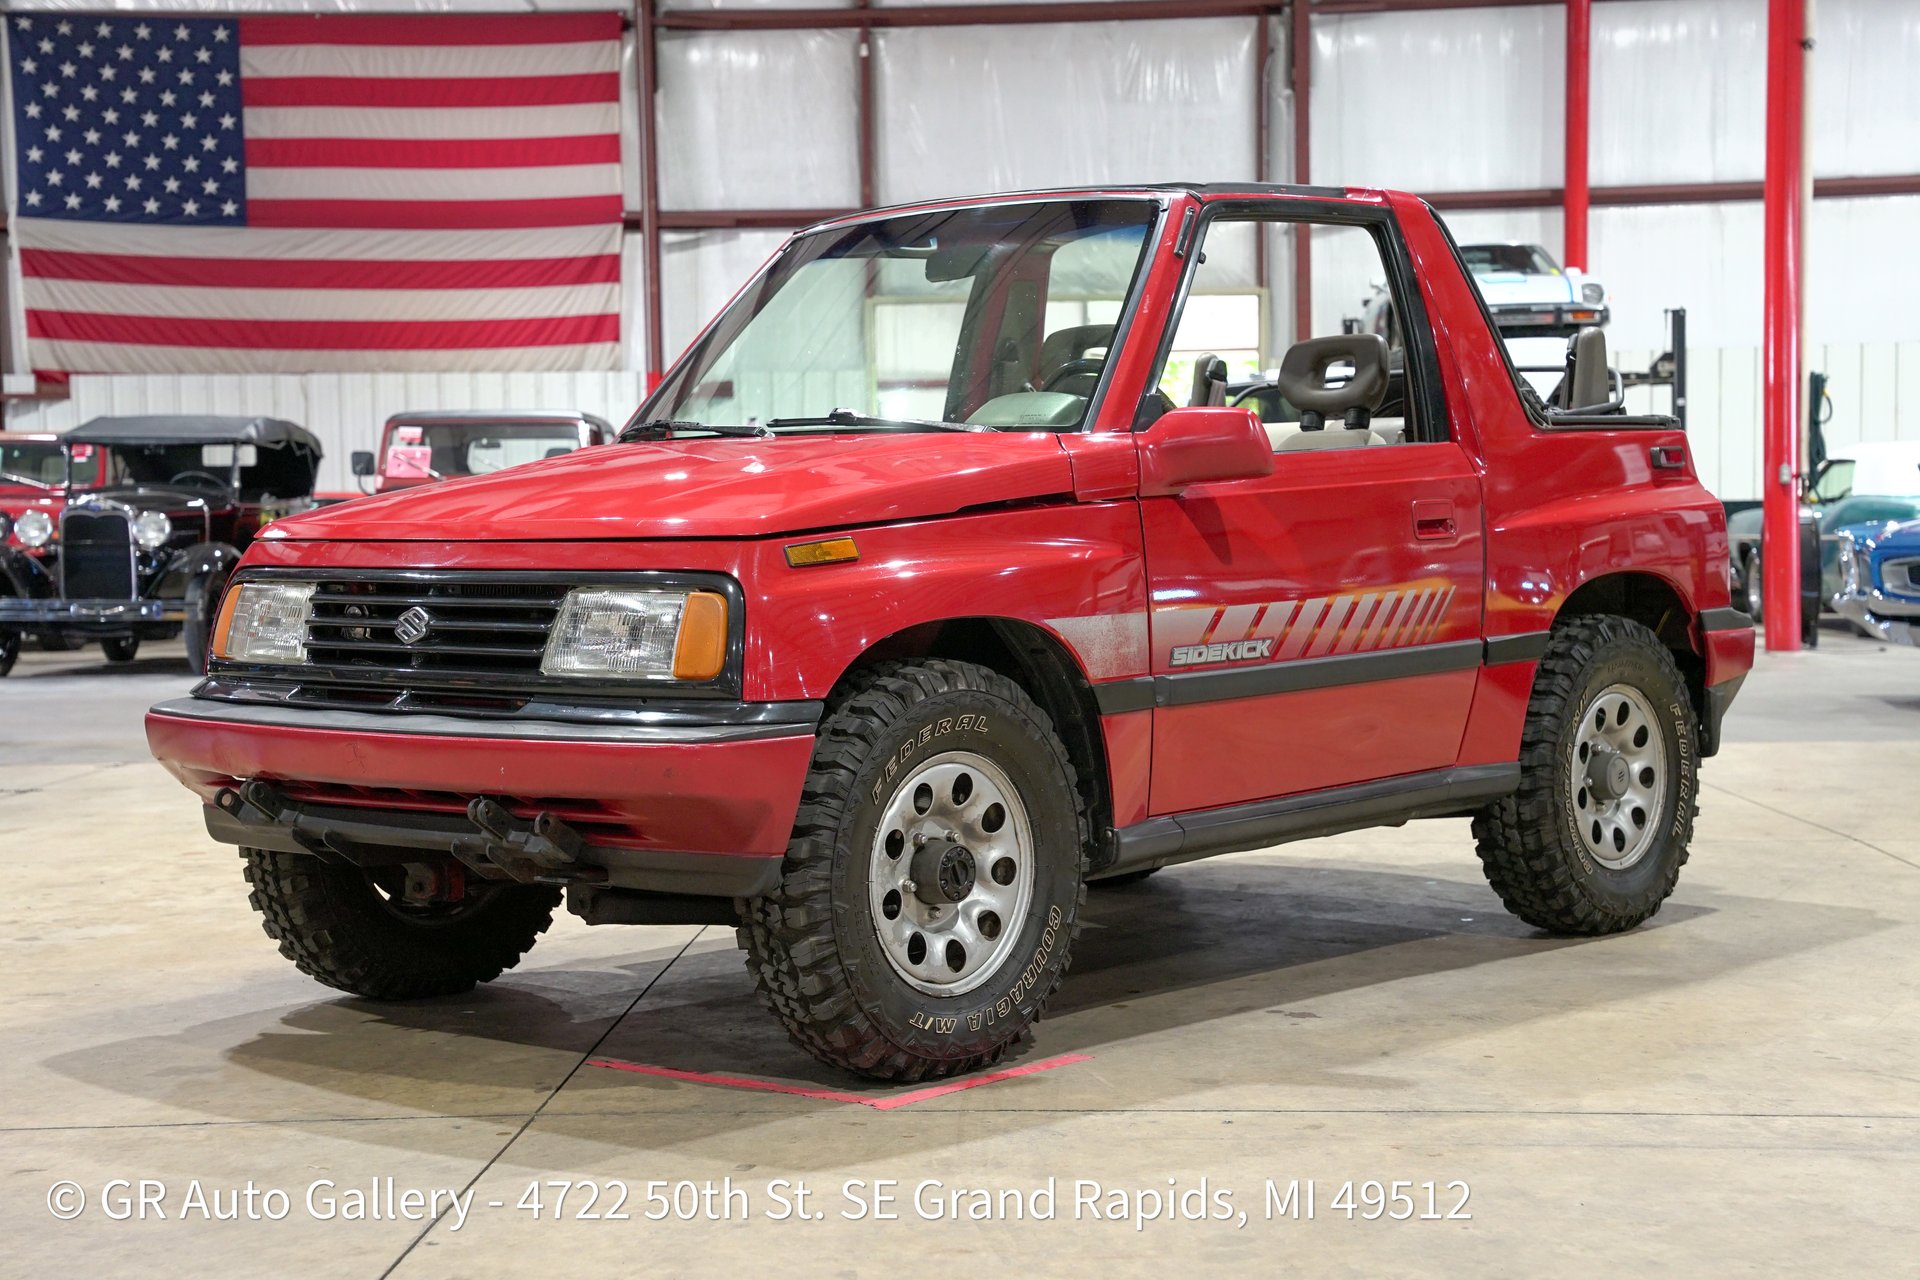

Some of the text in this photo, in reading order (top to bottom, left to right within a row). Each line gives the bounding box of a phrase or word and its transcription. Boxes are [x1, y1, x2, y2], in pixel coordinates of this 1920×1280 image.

[1170, 639, 1274, 666] SIDEKICK
[872, 714, 991, 805] FEDERAL
[1669, 703, 1690, 838] FEDERAL
[967, 904, 1062, 1034] COURAGIA
[909, 1011, 958, 1035] M/T
